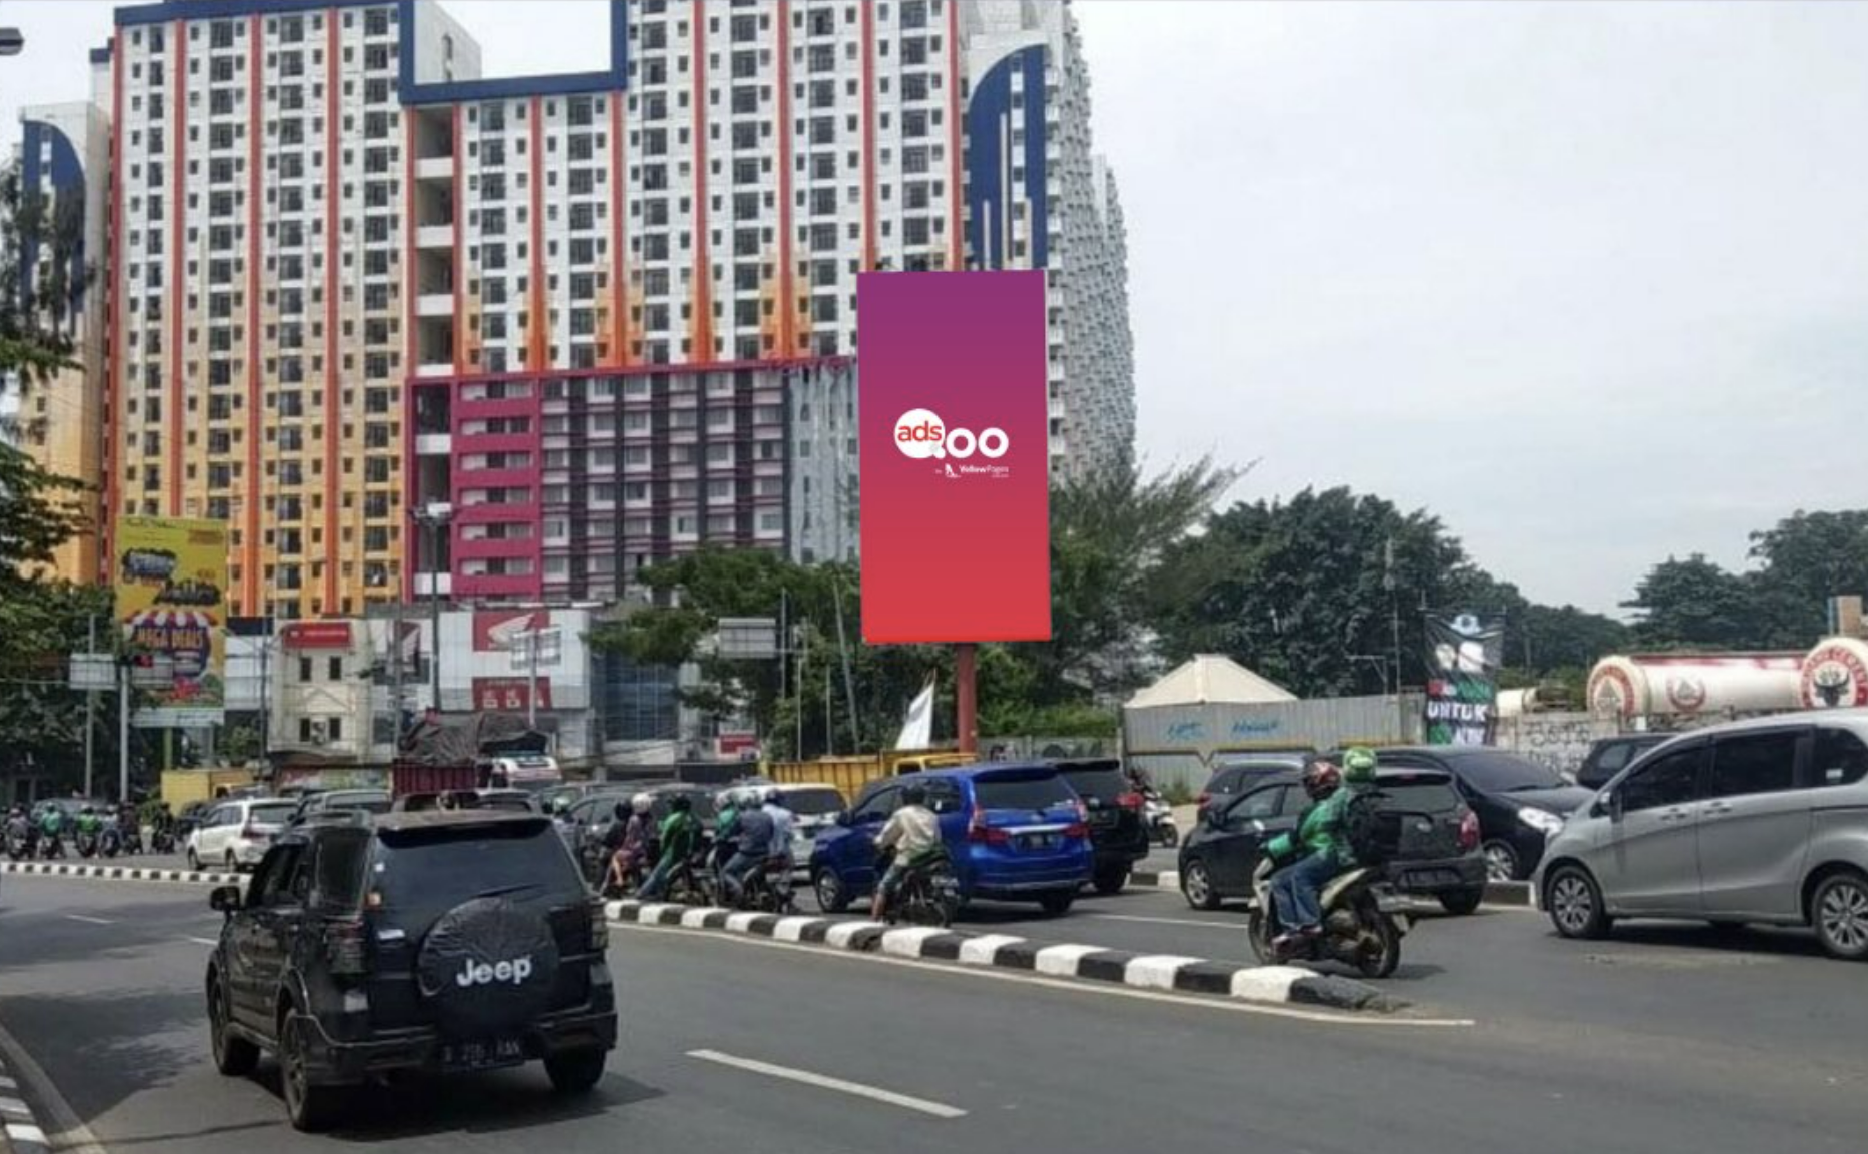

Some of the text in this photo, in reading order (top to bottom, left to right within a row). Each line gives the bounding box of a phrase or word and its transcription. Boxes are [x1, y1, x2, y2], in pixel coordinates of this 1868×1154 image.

[897, 420, 943, 443] ads
[1427, 701, 1487, 722] UNTUK
[456, 957, 532, 987] Jeep
